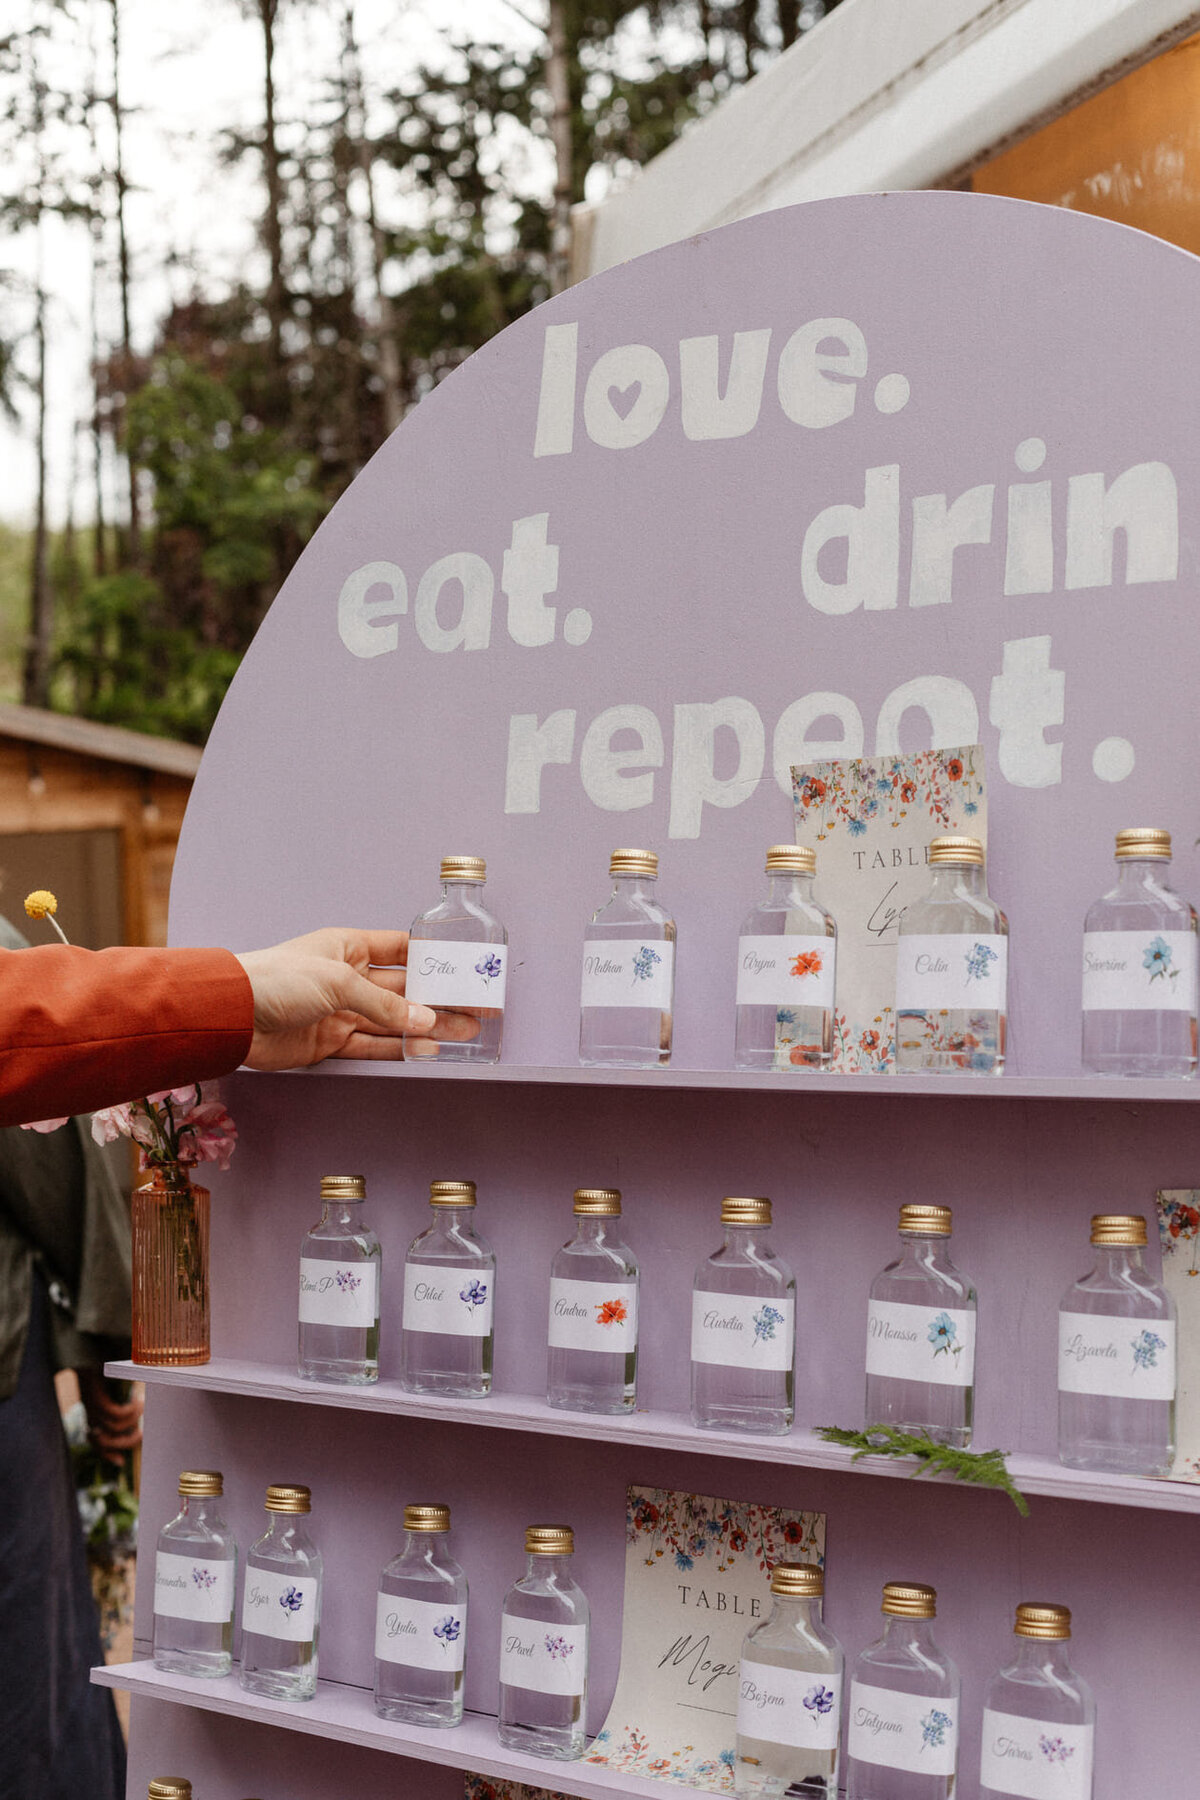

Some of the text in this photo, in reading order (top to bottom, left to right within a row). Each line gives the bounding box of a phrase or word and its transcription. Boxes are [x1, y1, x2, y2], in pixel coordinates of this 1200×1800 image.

[533, 316, 911, 458] love.
[337, 512, 593, 659] eat.
[503, 634, 1136, 841] repeat.
[584, 956, 624, 976] Nathan
[742, 951, 777, 975] Aryna
[914, 953, 949, 976] Colin
[318, 1276, 335, 1294] P
[413, 1282, 446, 1302] Chloé
[554, 1297, 588, 1318] Andrea
[1063, 1333, 1118, 1363] Lizaveta
[247, 1585, 271, 1609] Igor
[677, 1584, 761, 1618] TABLE
[385, 1611, 419, 1639] Yulia
[504, 1635, 536, 1657] Pavel
[854, 1706, 904, 1737] Tatyana
